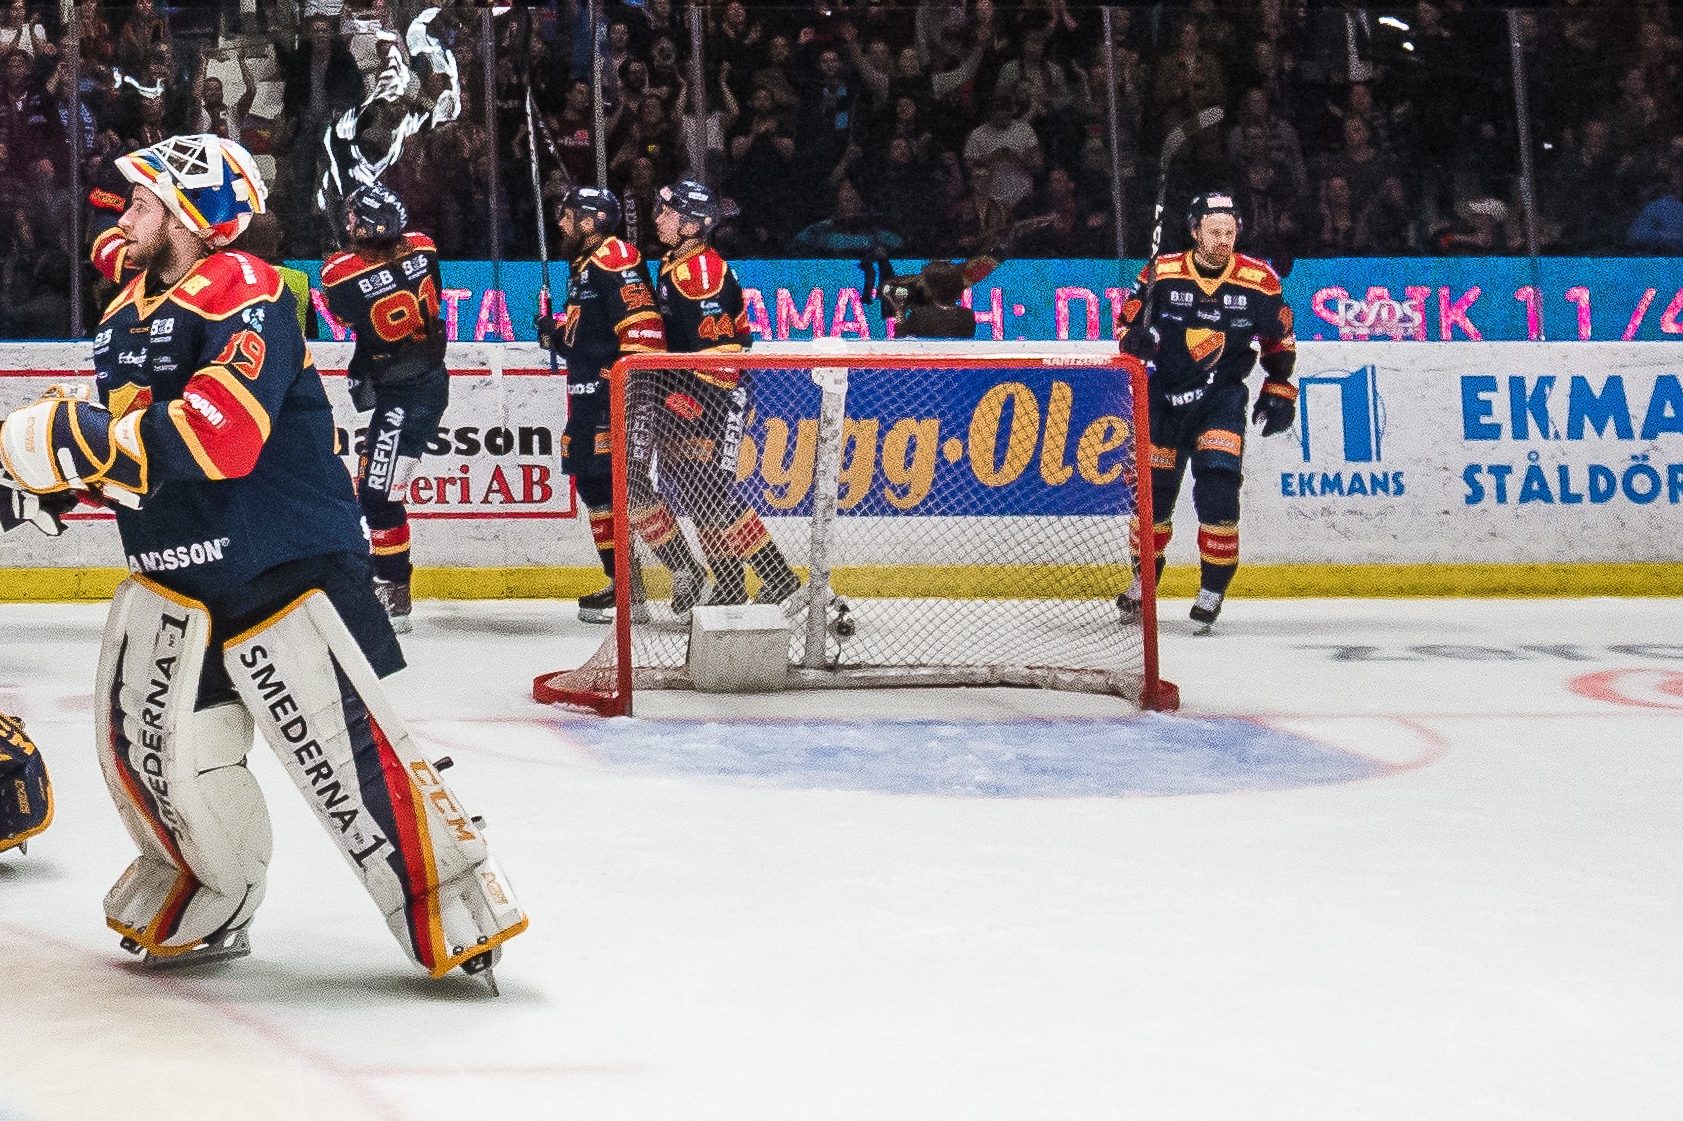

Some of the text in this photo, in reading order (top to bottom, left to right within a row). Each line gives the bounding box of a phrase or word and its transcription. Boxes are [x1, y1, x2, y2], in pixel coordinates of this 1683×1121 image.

[1460, 374, 1683, 441] EKMA
[367, 429, 401, 491] REFIX
[481, 464, 553, 505] AB
[1280, 470, 1407, 497] EKMANS
[239, 644, 360, 835] SMEDERNA
[409, 758, 476, 842] CCM
